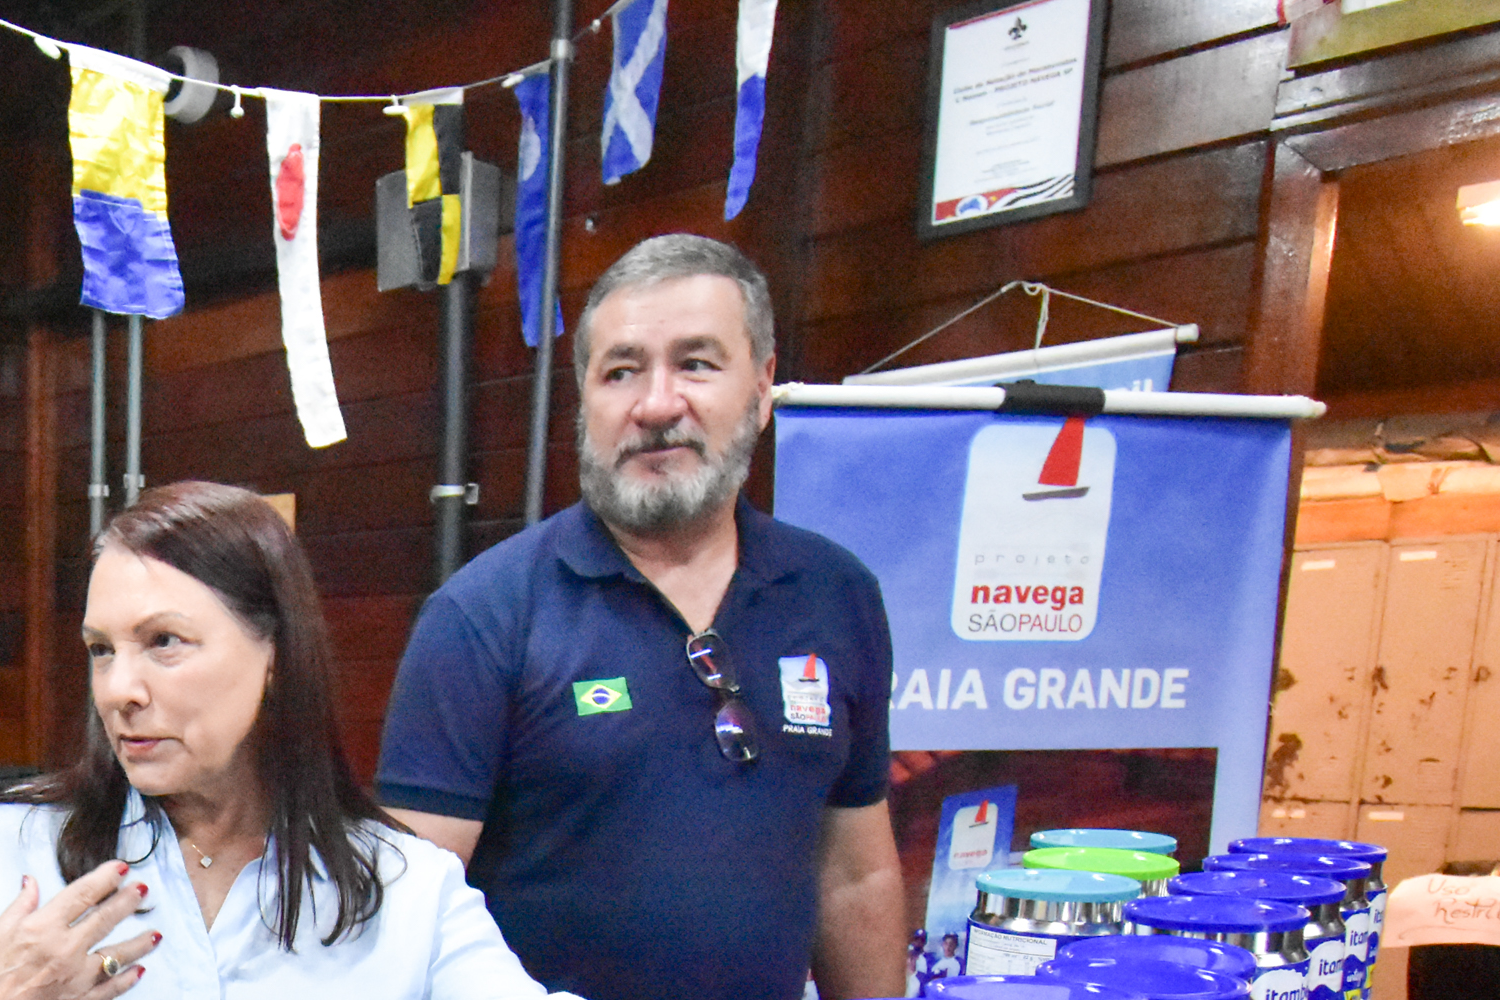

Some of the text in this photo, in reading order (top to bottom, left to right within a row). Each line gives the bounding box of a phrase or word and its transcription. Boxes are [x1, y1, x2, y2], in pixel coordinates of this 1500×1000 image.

[974, 552, 1090, 566] projeto
[970, 584, 1085, 612] navega
[967, 609, 1083, 633] SÃOPAULO
[1002, 668, 1190, 710] GRANDE
[782, 724, 806, 734] PRAIA
[1427, 878, 1470, 895] Uso
